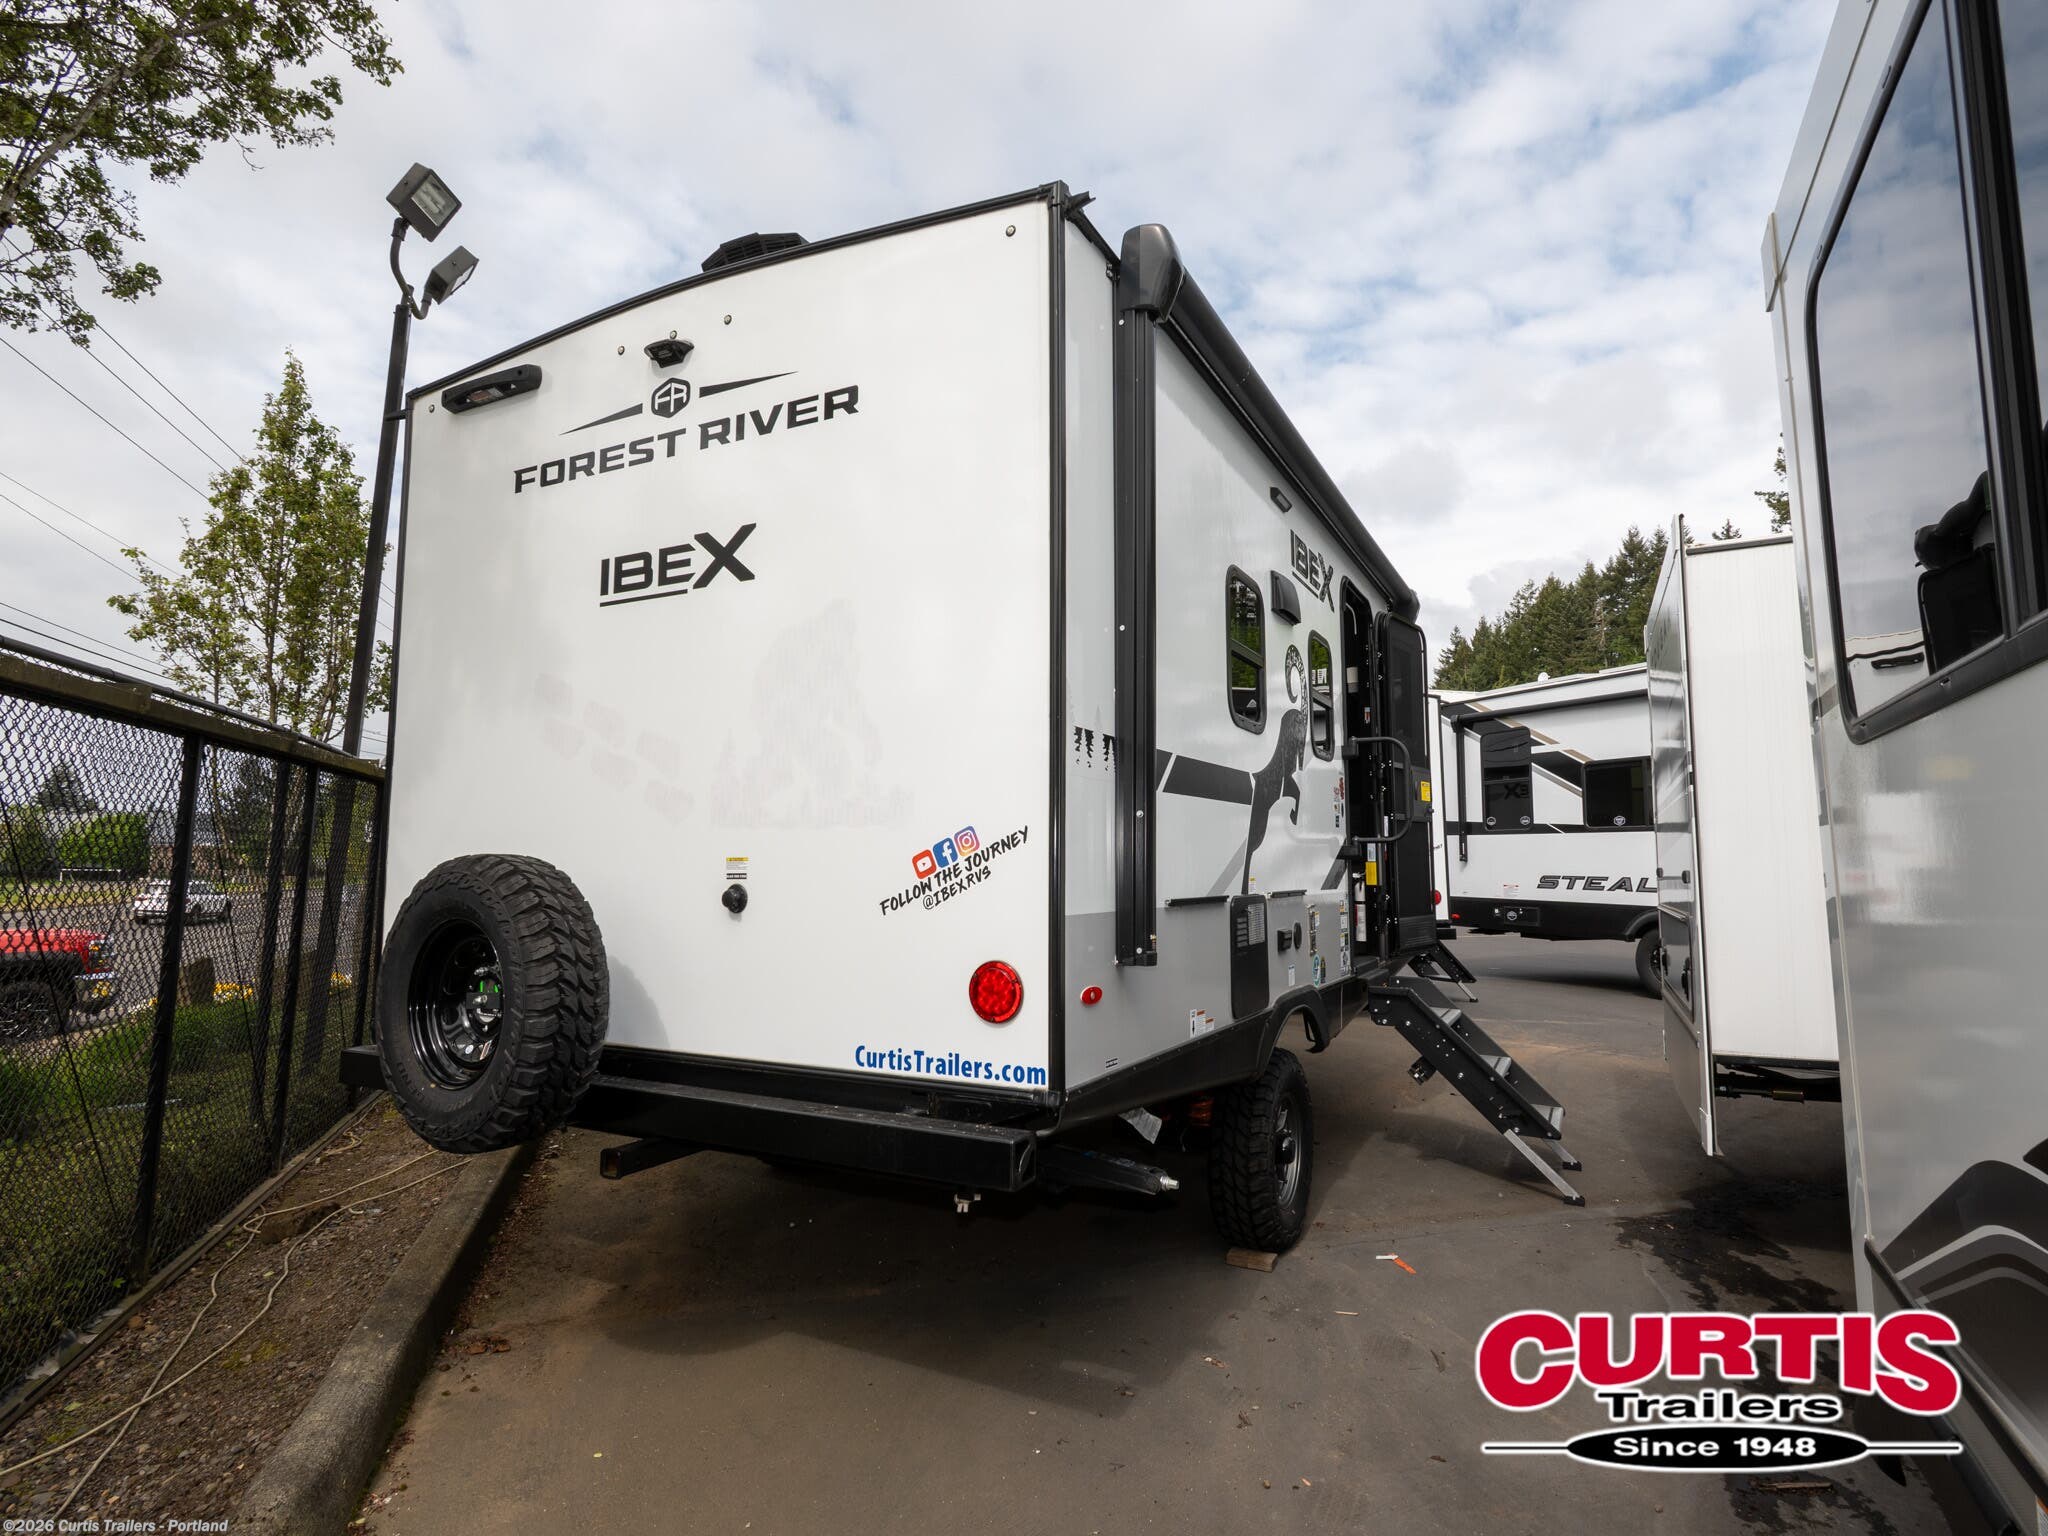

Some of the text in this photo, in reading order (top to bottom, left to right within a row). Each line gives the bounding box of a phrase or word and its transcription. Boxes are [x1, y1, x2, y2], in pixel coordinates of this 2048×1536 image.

[513, 384, 860, 494] FOREST RIVER
[599, 522, 757, 597] IBEX
[1290, 528, 1335, 613] IBEX
[879, 825, 1029, 915] FOLLOW THE JOURNEY
[855, 1045, 1047, 1086] CurtisTrailers.com
